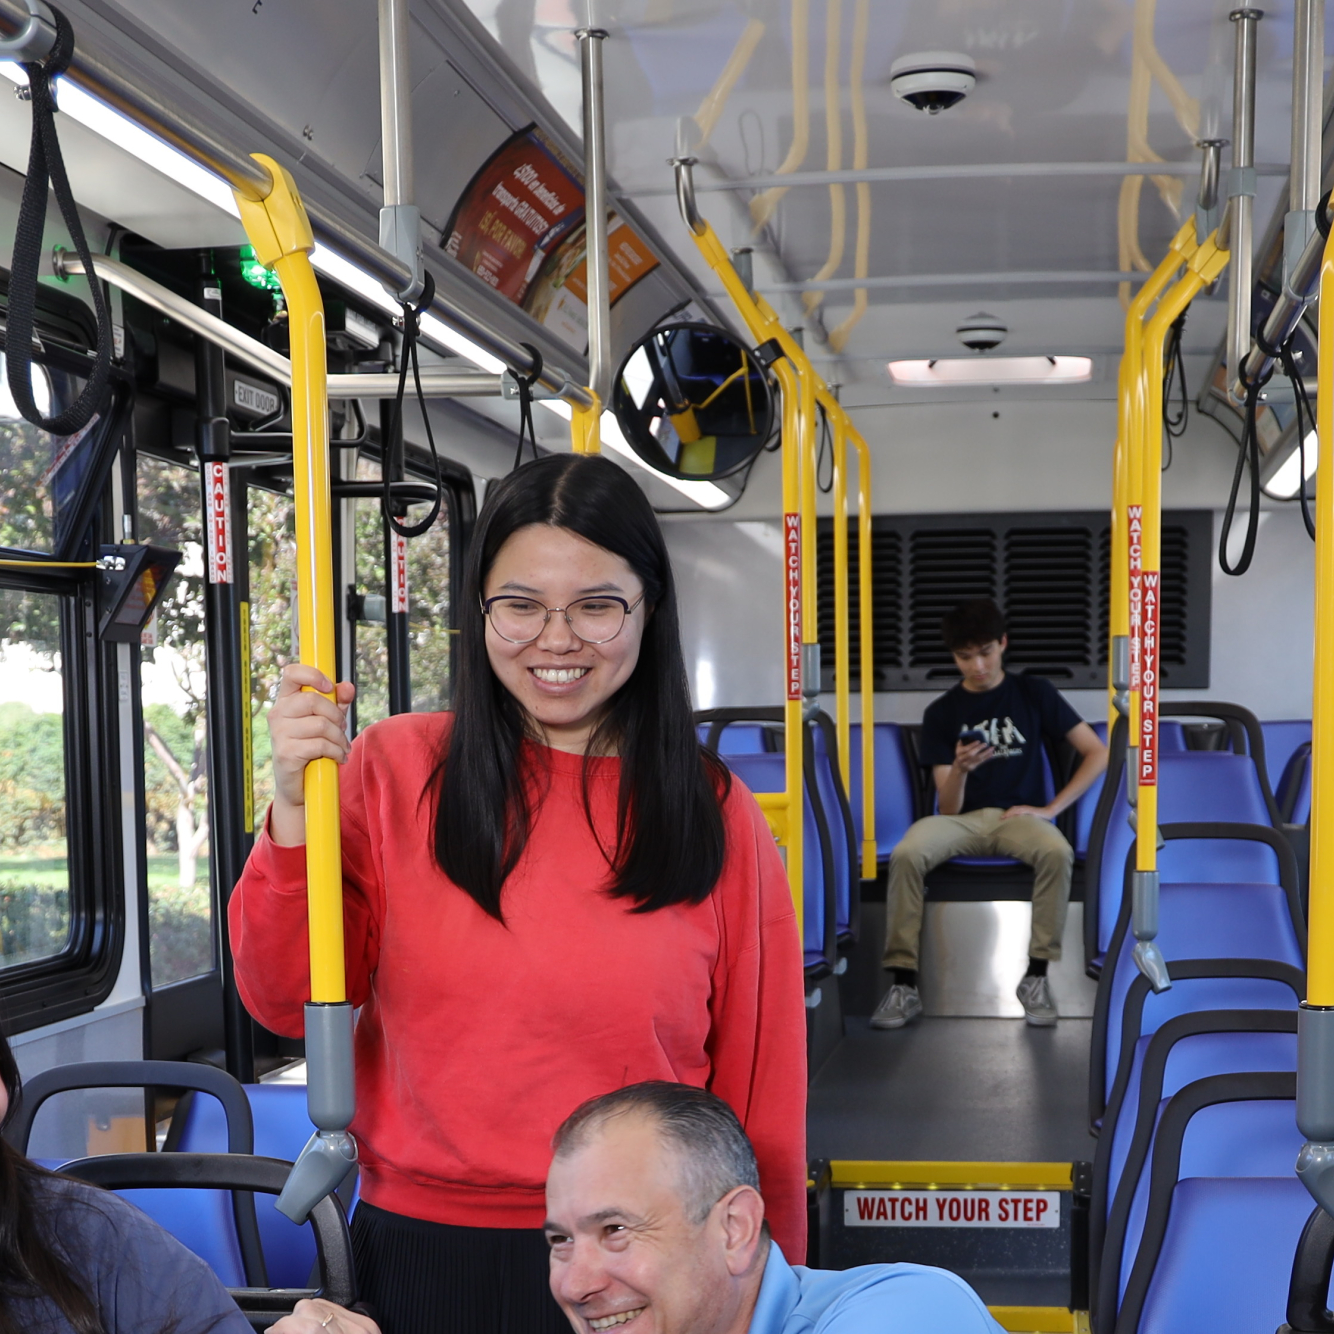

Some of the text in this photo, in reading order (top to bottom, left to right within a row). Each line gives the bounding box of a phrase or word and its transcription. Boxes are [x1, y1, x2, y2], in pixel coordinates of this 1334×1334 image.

[238, 386, 275, 412] EXIT DOOR
[213, 464, 226, 582] CAUTION
[1128, 506, 1142, 687] WATCH YOUR STEP
[786, 515, 800, 693] WATCH YOUR STEP
[1142, 574, 1158, 778] WATCH YOUR STEP
[857, 1197, 1049, 1223] WATCH YOUR STEP
